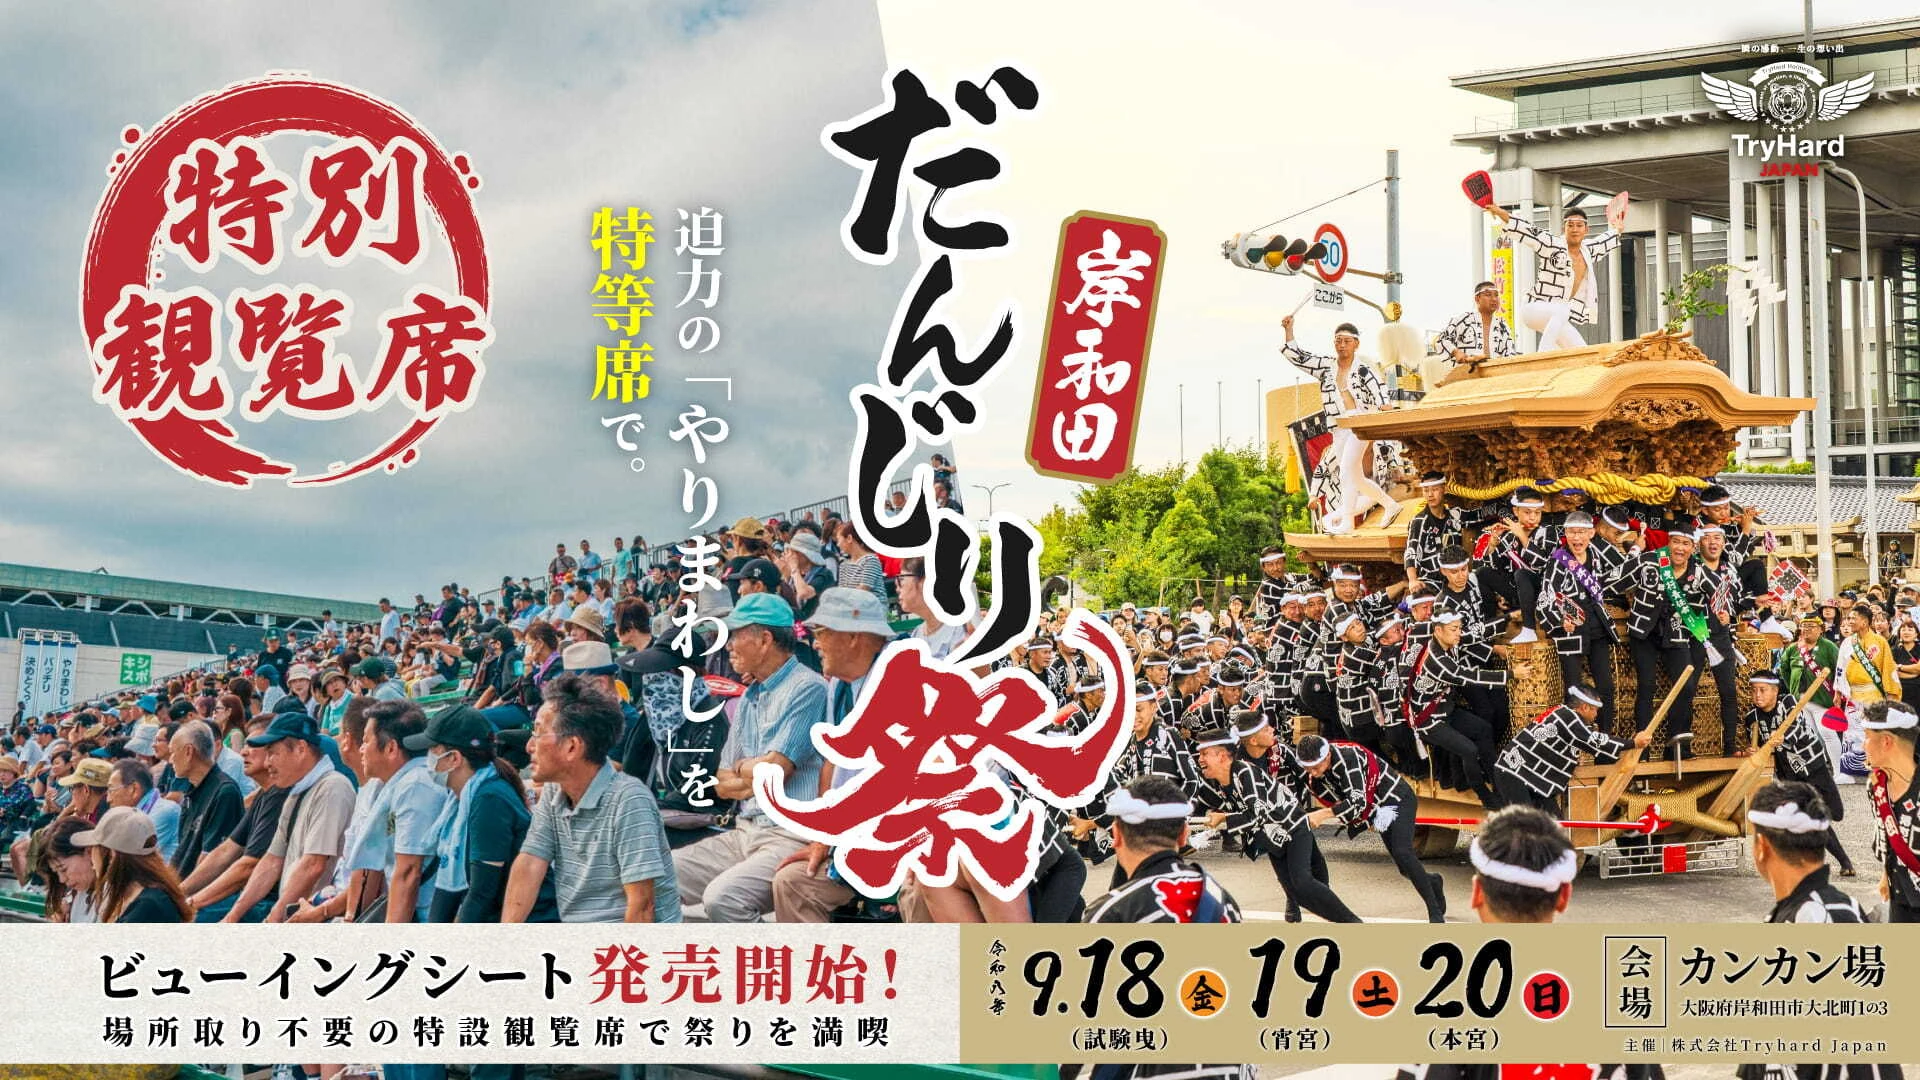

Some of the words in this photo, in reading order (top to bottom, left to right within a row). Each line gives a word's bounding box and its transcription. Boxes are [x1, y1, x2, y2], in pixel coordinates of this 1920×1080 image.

[1315, 289, 1343, 305] ここから
[123, 656, 150, 669] キシ
[42, 656, 55, 694] バッチリ
[60, 658, 72, 706] やりまわし
[122, 669, 149, 682] スポ
